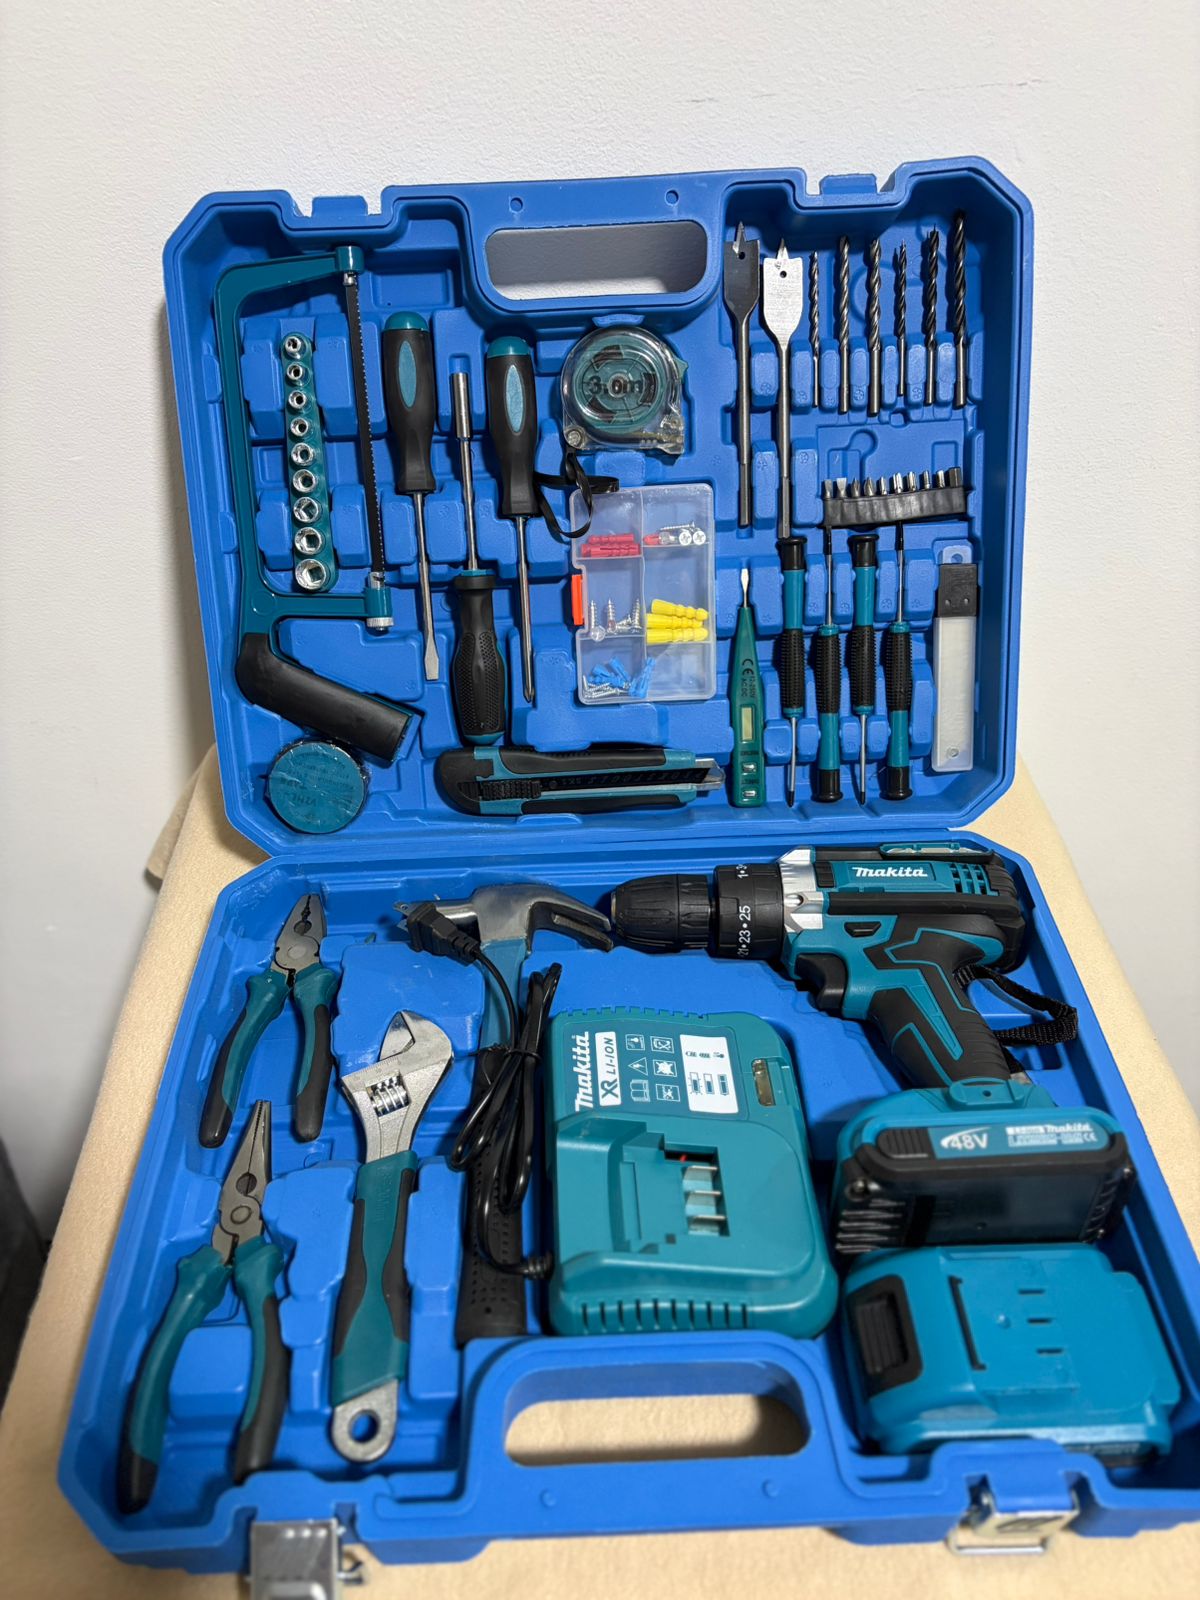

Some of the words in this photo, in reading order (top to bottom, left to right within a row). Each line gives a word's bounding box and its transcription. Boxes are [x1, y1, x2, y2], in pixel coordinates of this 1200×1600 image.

[741, 658, 754, 676] CE
[852, 866, 928, 878] Makita
[603, 1037, 616, 1076] LI-ION
[572, 1031, 594, 1112] Makita
[950, 1133, 988, 1151] 48V
